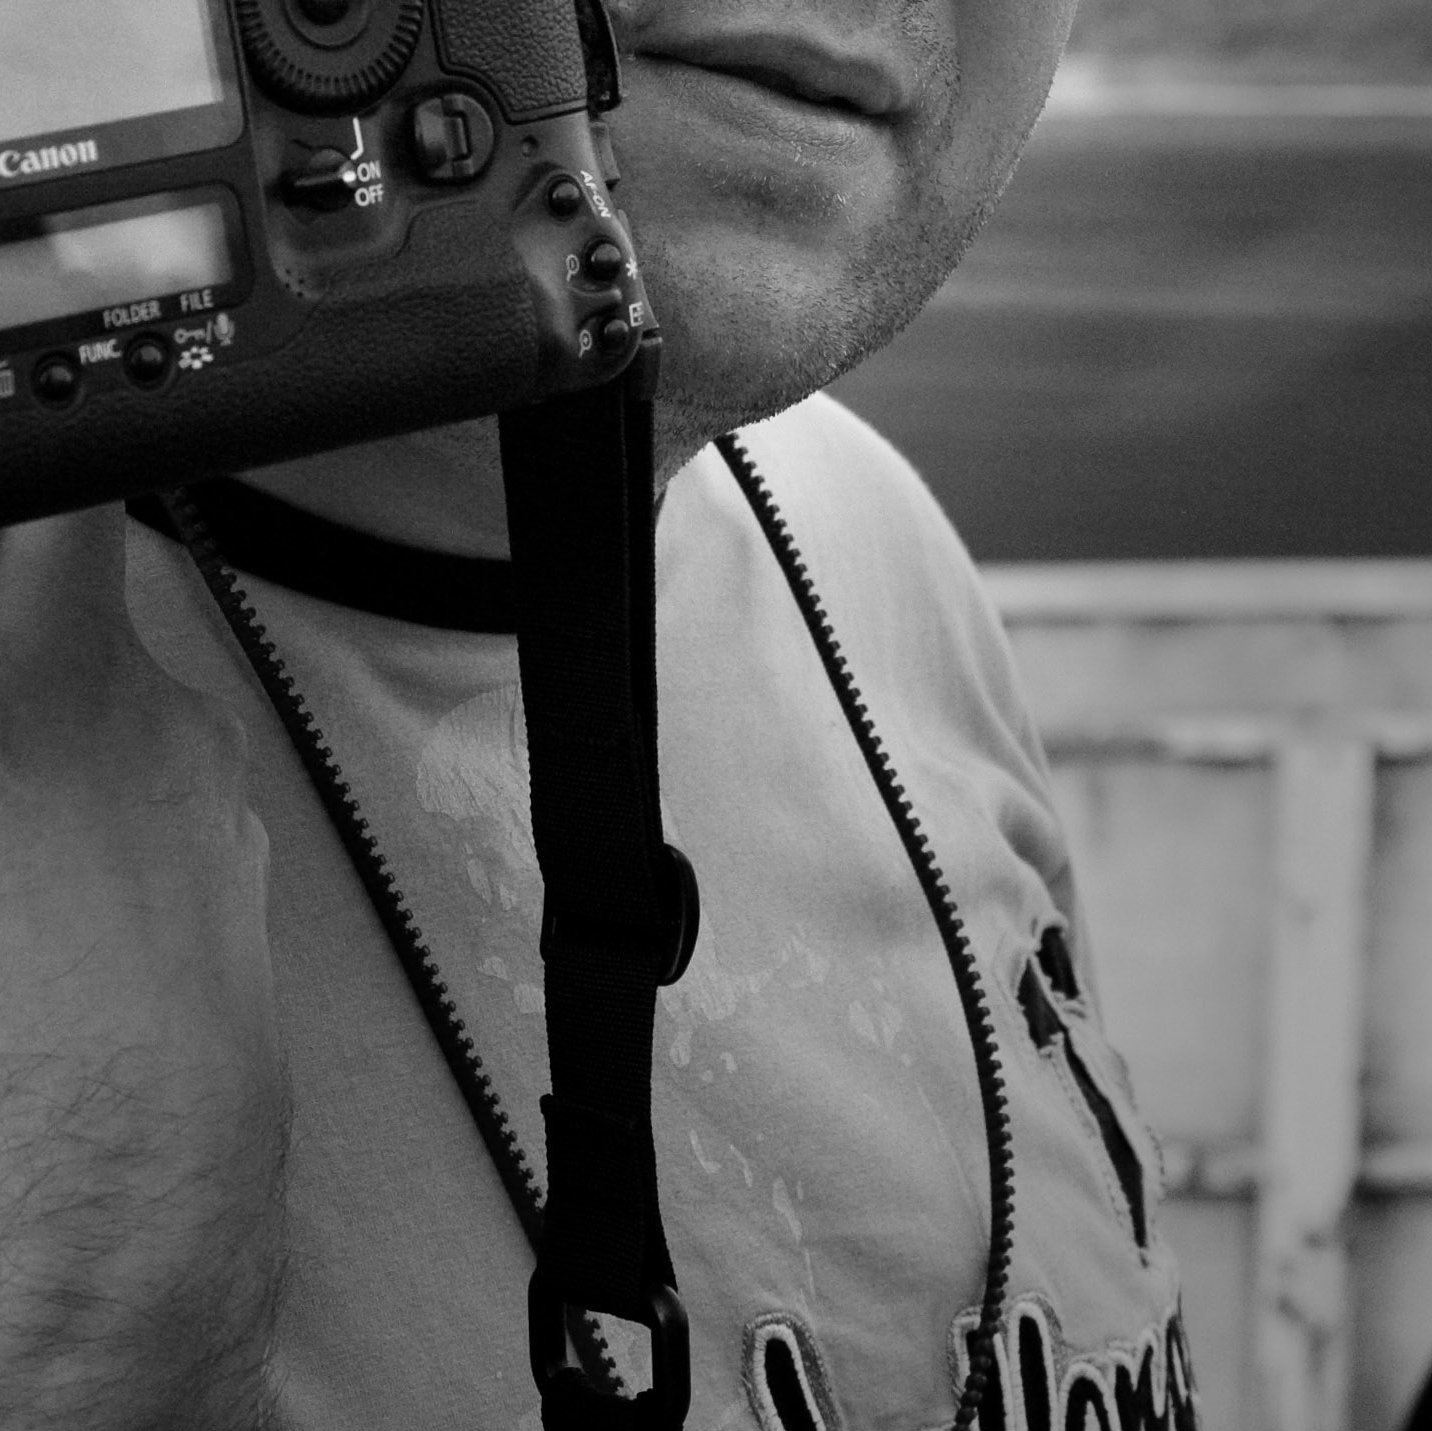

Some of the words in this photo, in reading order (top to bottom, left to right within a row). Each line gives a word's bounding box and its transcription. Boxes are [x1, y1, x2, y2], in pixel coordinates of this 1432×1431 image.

[356, 161, 382, 182] ON
[354, 183, 385, 208] OFF
[579, 168, 613, 219] AF-ON
[179, 288, 215, 313] FILE
[102, 298, 163, 329] FOLDER
